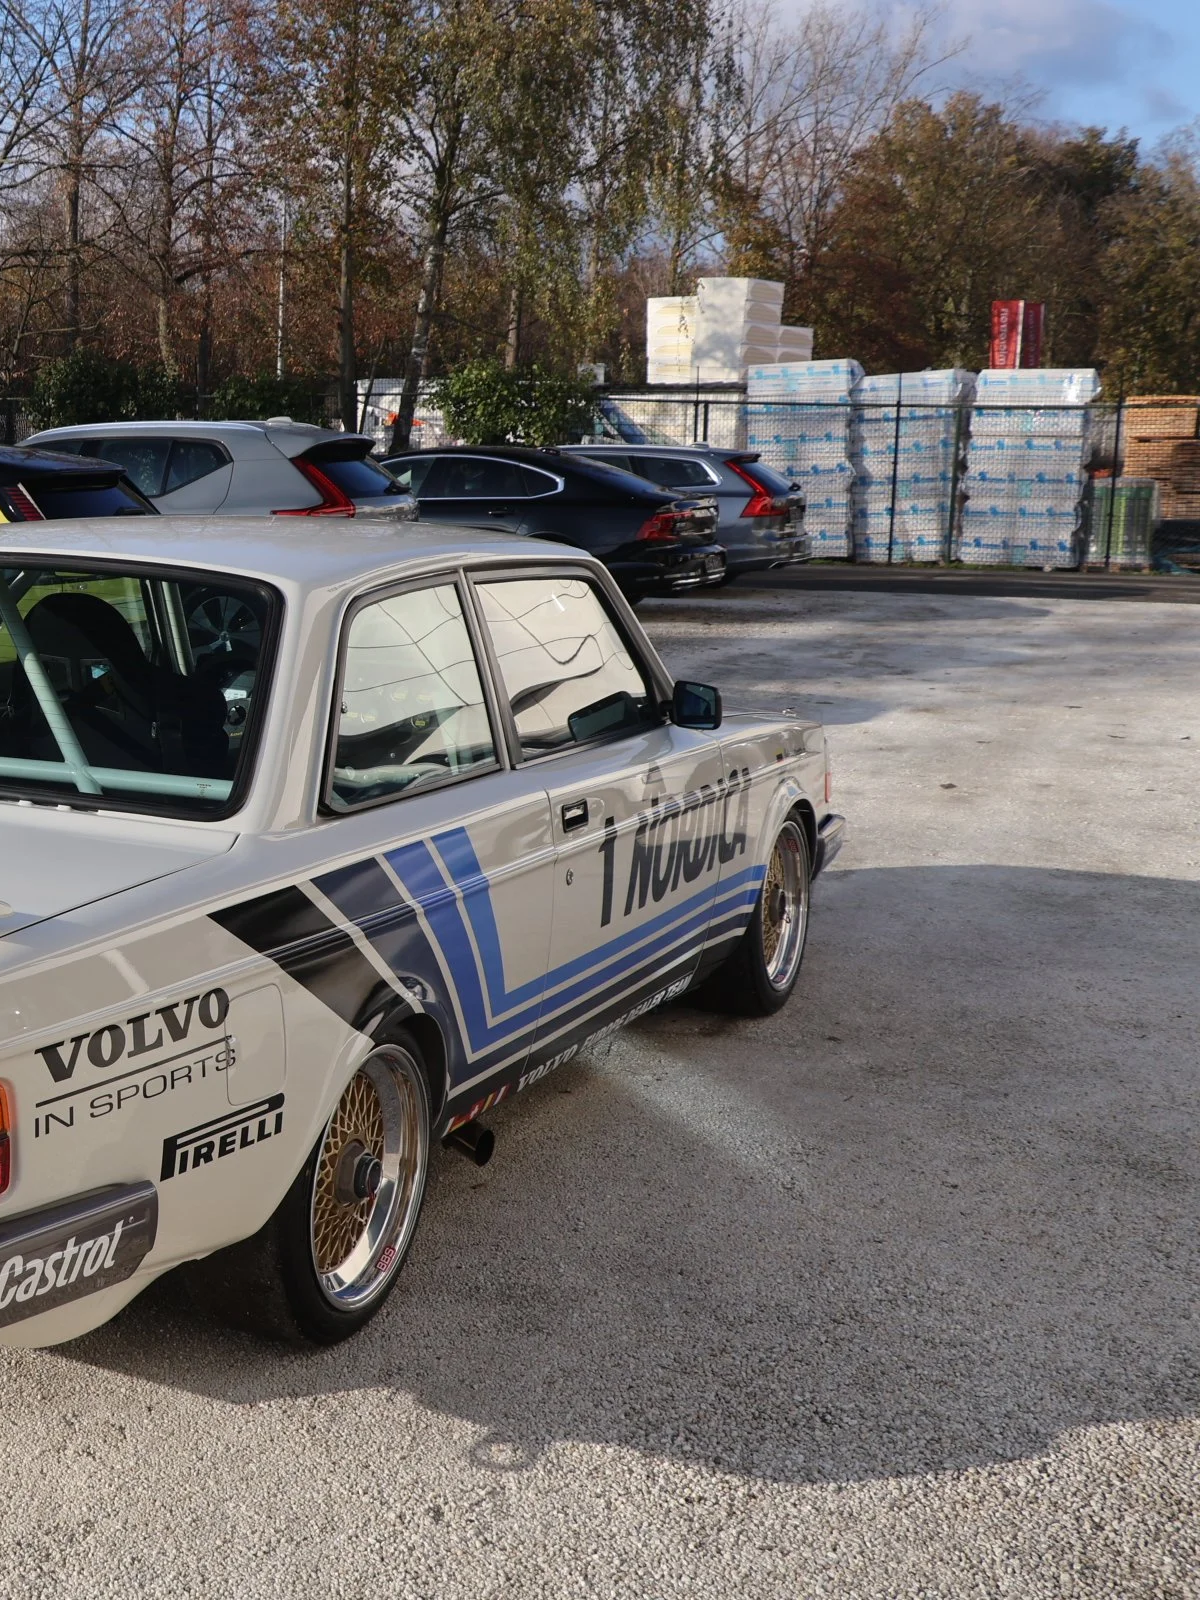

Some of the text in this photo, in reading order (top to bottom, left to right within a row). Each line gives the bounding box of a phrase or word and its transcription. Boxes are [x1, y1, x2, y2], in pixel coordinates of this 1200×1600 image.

[598, 762, 751, 928] 1 NORDICA
[35, 988, 229, 1083] VOLVO
[517, 1044, 578, 1092] VOLVO
[35, 1048, 236, 1138] IN SPORTS
[160, 1093, 285, 1182] PIRELLI
[378, 1248, 395, 1271] BBS
